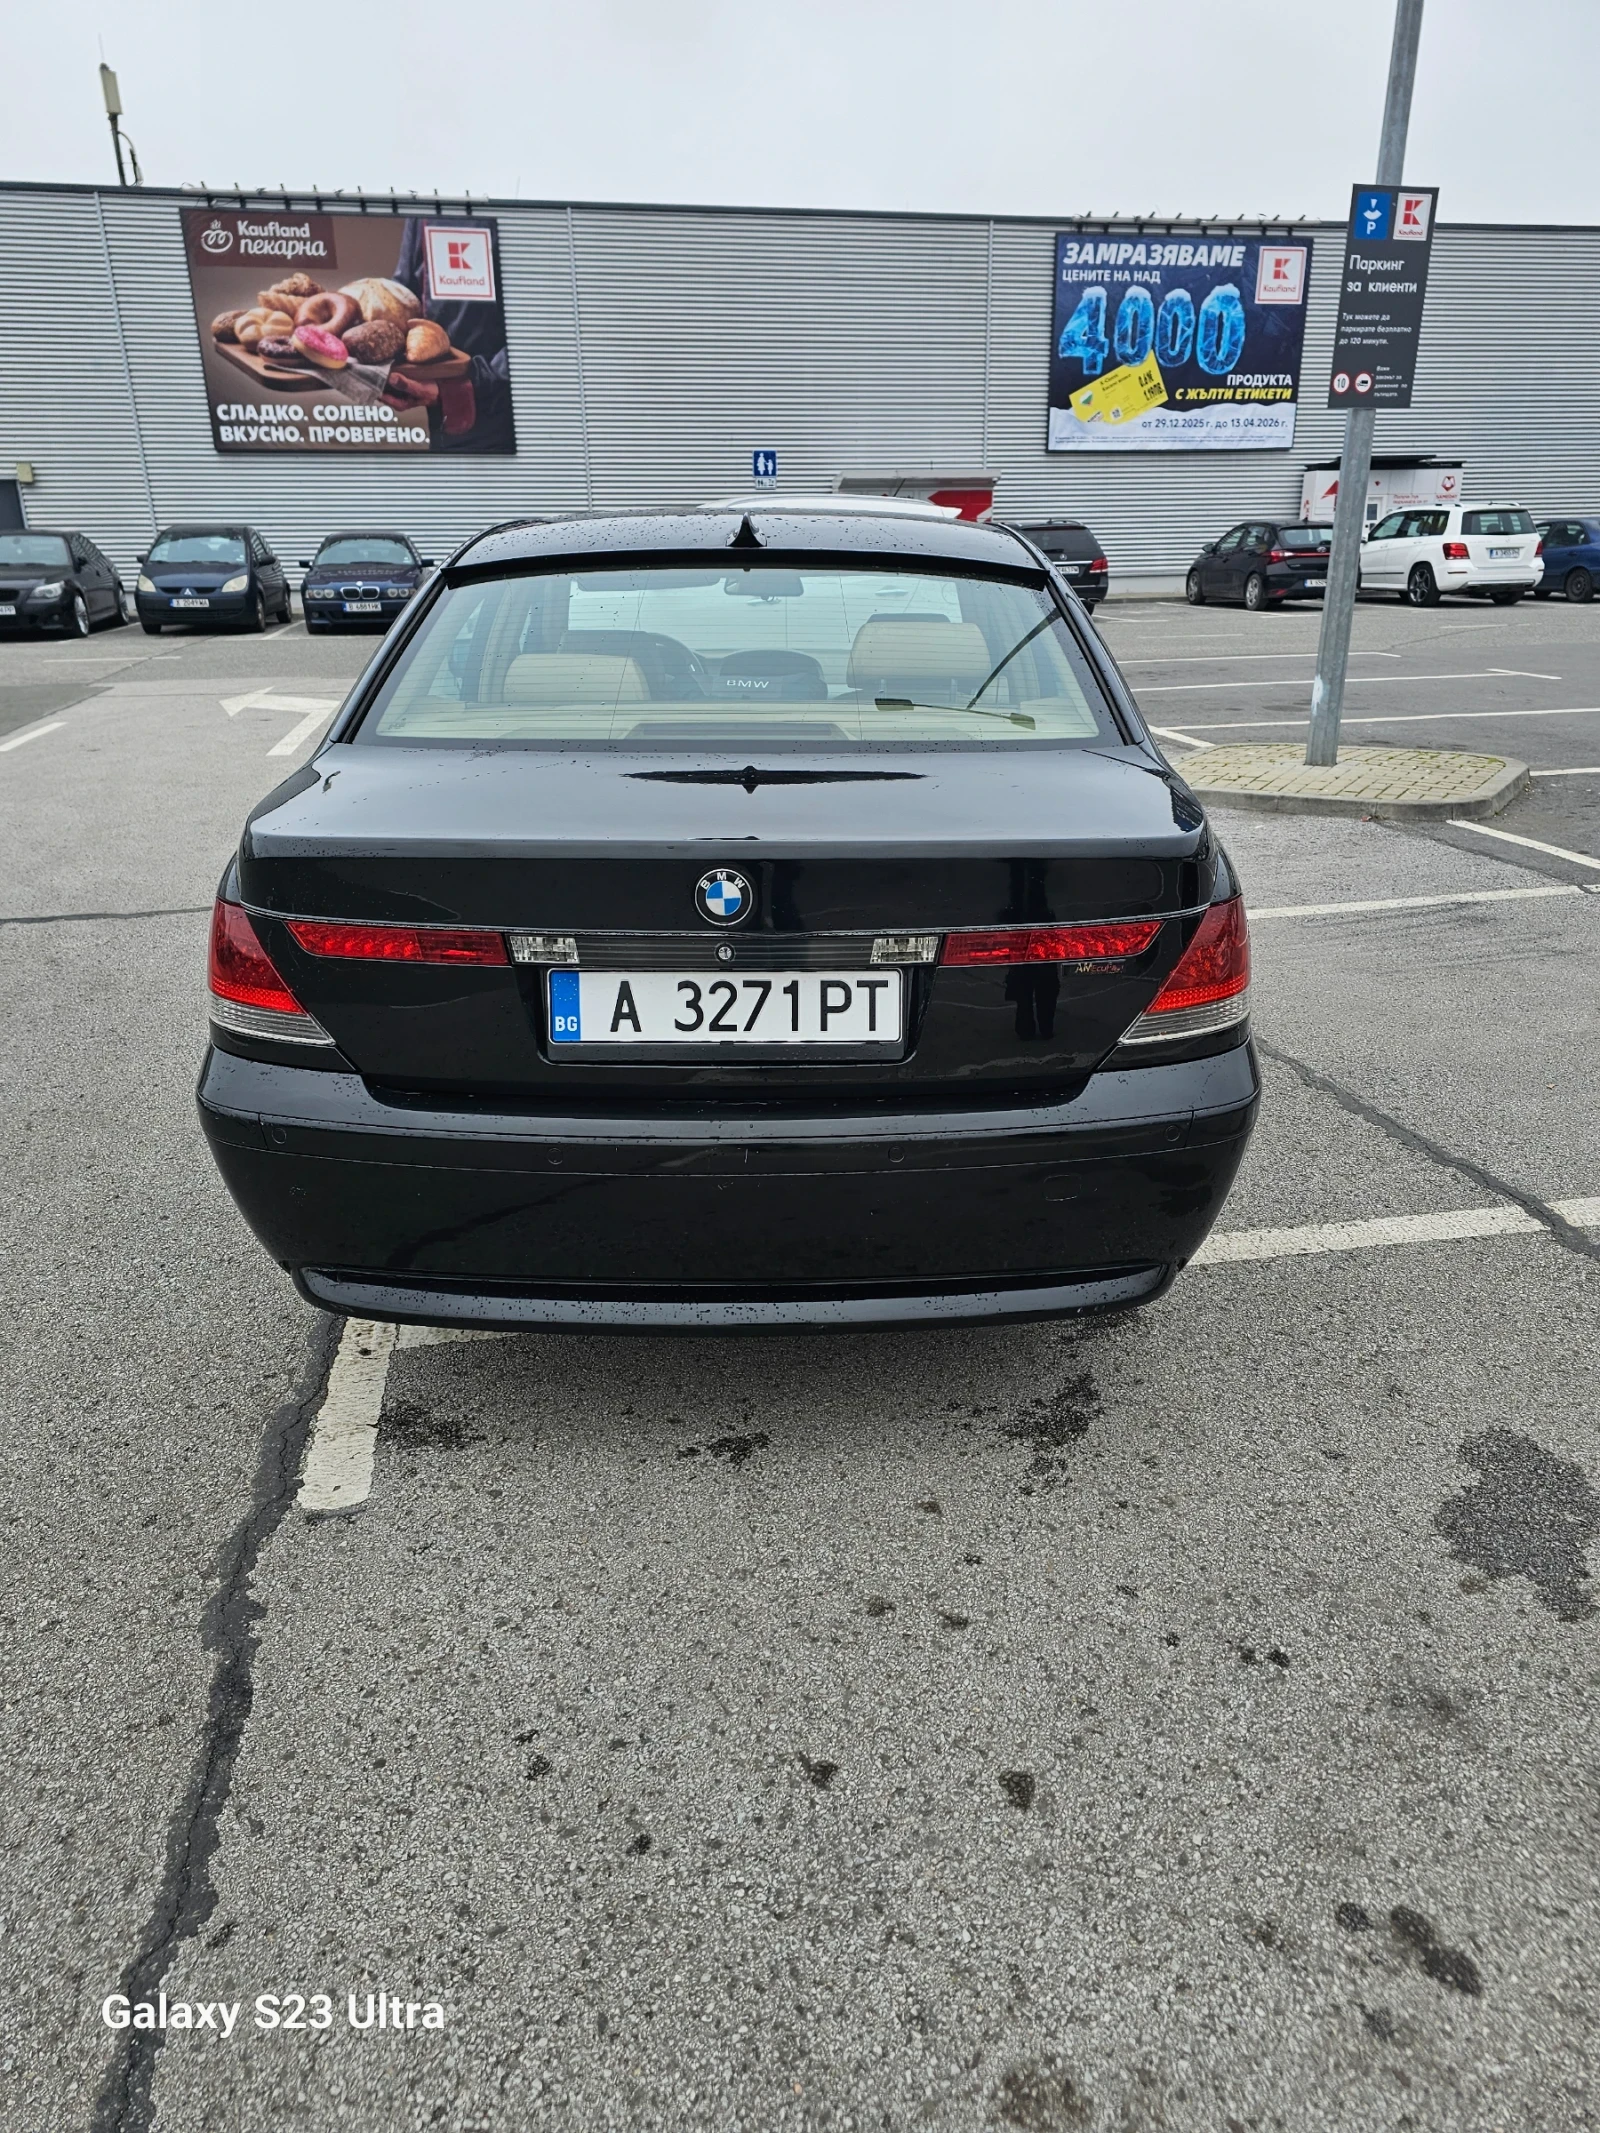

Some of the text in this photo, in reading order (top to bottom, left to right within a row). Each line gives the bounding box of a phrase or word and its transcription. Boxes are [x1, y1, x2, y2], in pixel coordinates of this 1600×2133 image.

[237, 219, 310, 239] Kaufland
[1366, 221, 1376, 235] P
[239, 239, 328, 260] пекарна
[1062, 242, 1247, 267] ЗАМРАЗЯВАМЕ
[1349, 254, 1406, 275] Паркинг
[438, 274, 486, 287] Kaufland
[1061, 269, 1162, 284] ЦЕНИТЕ НА НАД
[1262, 283, 1297, 294] Kaufland
[1346, 281, 1418, 293] за клиенти
[1342, 312, 1354, 322] Тук
[1380, 314, 1391, 322] да
[1058, 282, 1247, 376] 4000
[1340, 325, 1412, 334] паркирате безплатно
[1339, 338, 1349, 346] до
[1350, 337, 1362, 345] 120
[1226, 374, 1293, 388] ПРОДУКТА
[1337, 378, 1347, 389] 10
[1175, 387, 1293, 401] С ЖЪЛТИ ЕТИКЕТИ
[216, 404, 399, 425] СЛАДКО. СОЛЕНО.
[1141, 418, 1289, 430] от 29.12.2025 г. до 13.04.2026 г.
[219, 425, 431, 444] ВКУСНО. ПРОВЕРЕНО.
[726, 679, 770, 689] BMW
[700, 871, 746, 890] BMW
[554, 1015, 578, 1032] BG
[609, 980, 642, 1033] A
